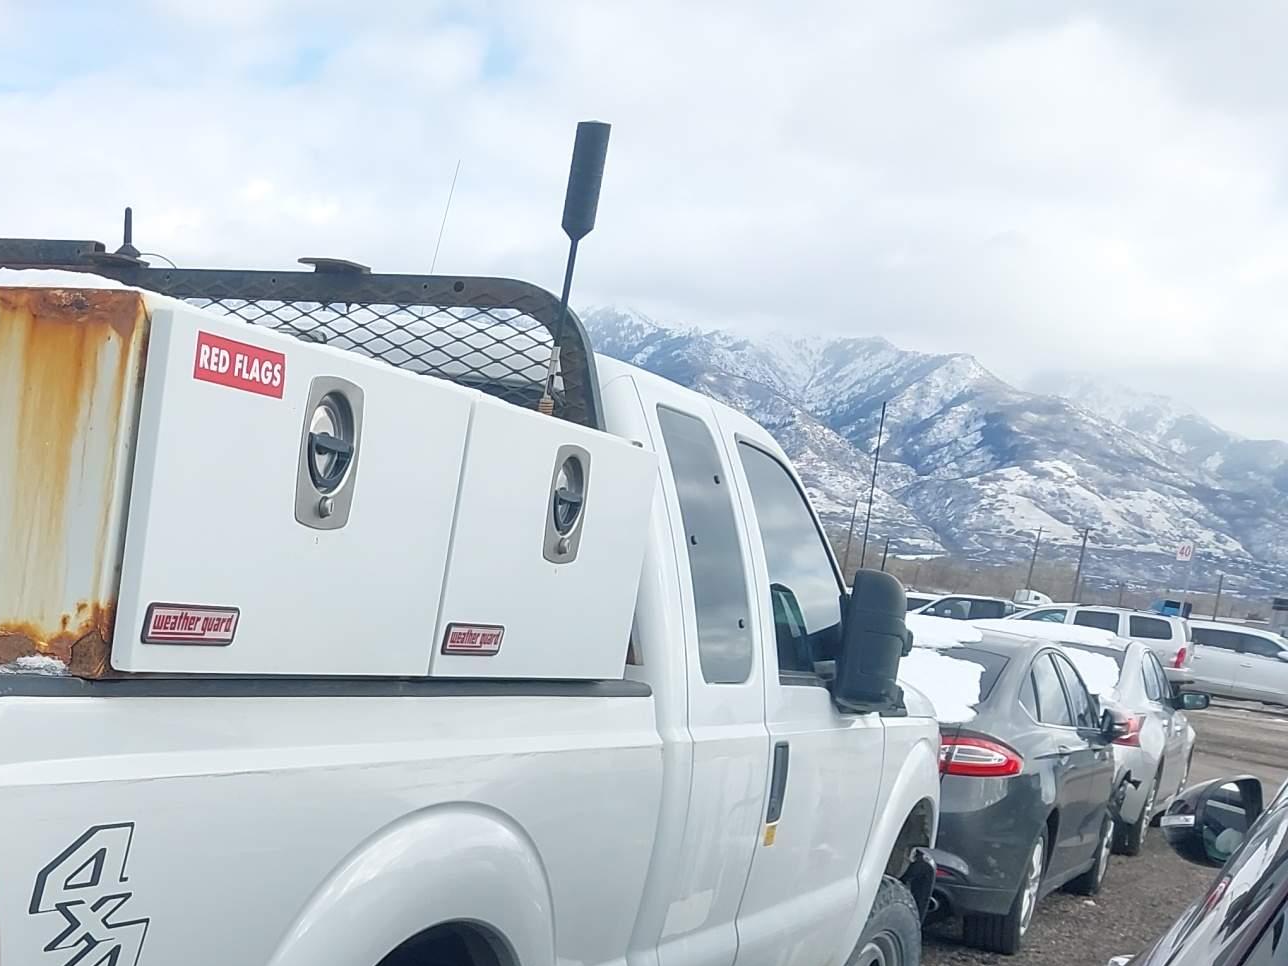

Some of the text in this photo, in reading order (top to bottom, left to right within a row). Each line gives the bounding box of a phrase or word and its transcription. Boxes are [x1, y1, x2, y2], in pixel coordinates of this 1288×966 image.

[199, 343, 282, 387] RED FLAGS
[1179, 545, 1191, 557] 40
[152, 612, 234, 636] weather guard
[449, 630, 501, 648] weather guard
